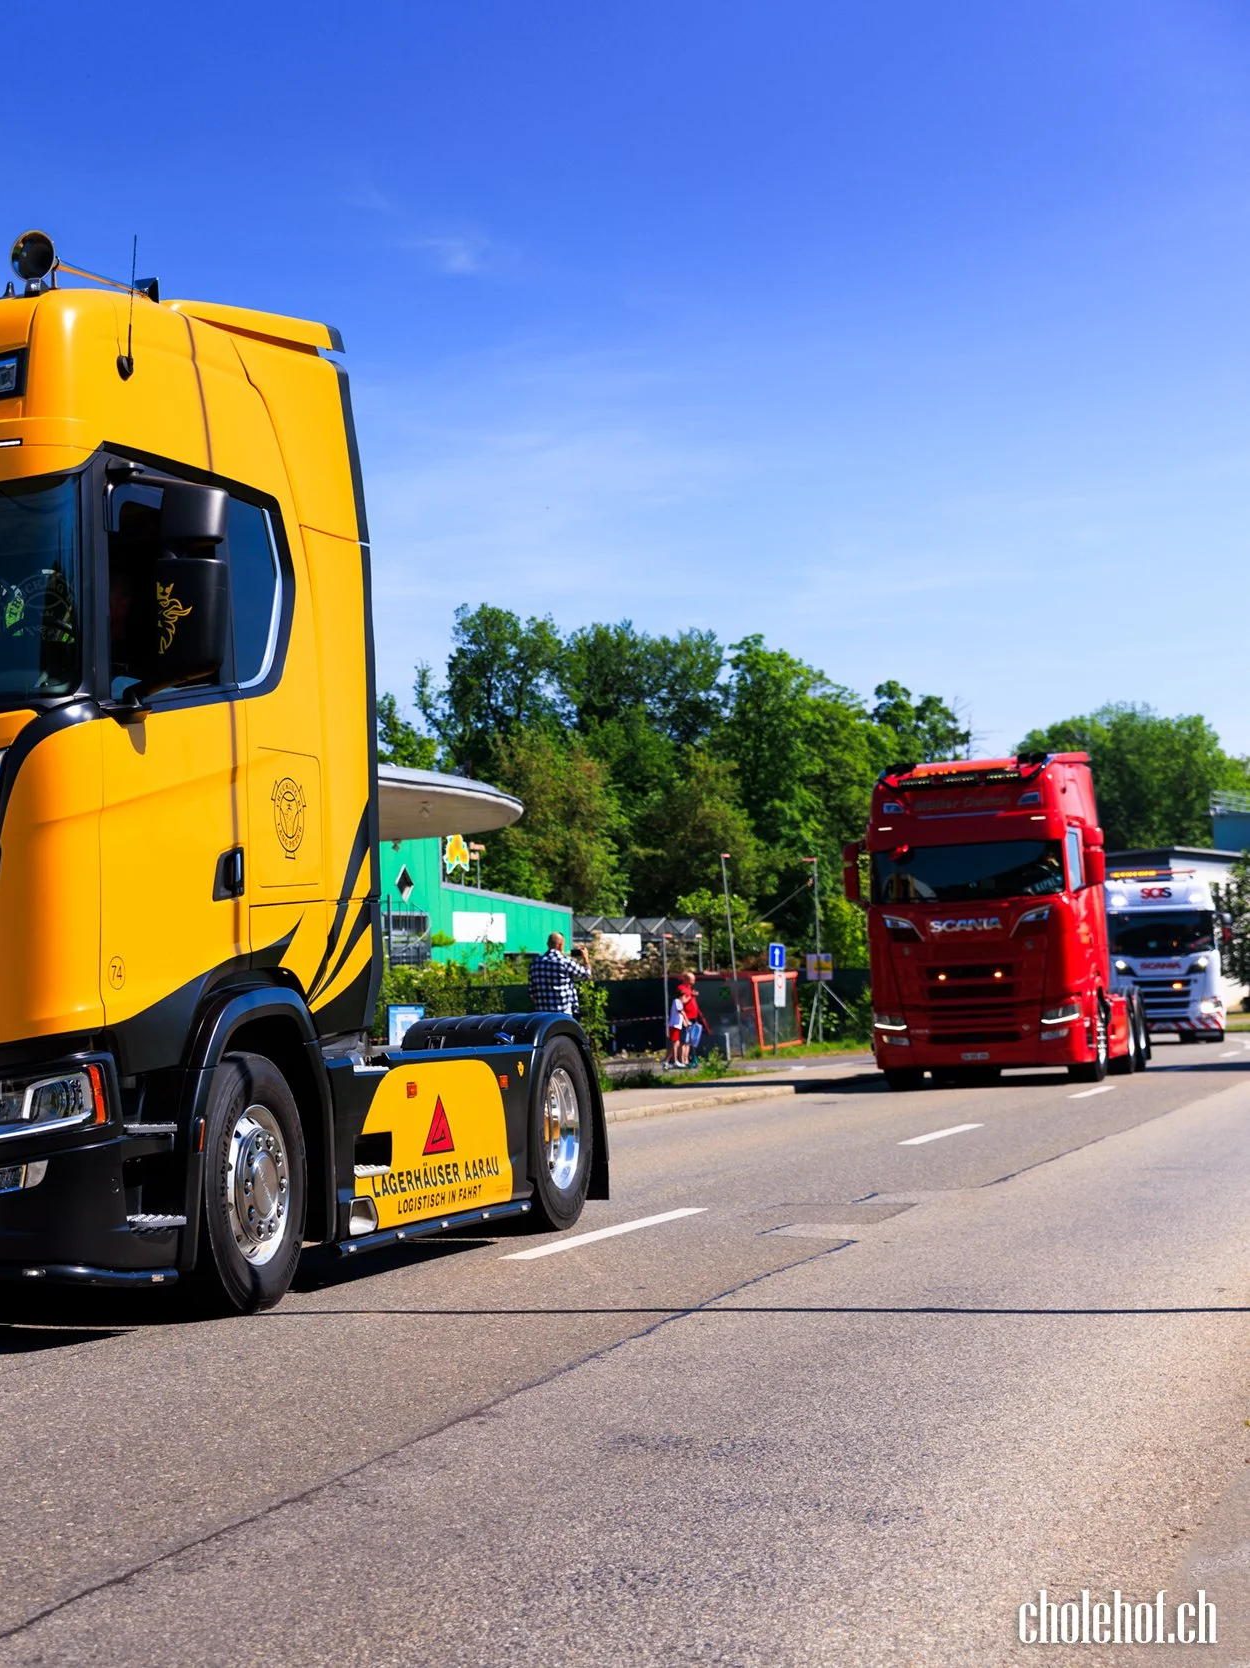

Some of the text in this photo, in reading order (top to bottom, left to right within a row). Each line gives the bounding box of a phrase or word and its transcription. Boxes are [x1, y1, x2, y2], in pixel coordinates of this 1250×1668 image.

[930, 917, 1002, 932] SCANIA
[111, 965, 123, 981] 74
[372, 1156, 500, 1198] LAGERHÄUSER AARAU
[398, 1192, 446, 1214] LOGISTISCH
[448, 1190, 456, 1202] IN
[458, 1184, 482, 1202] FAHRT
